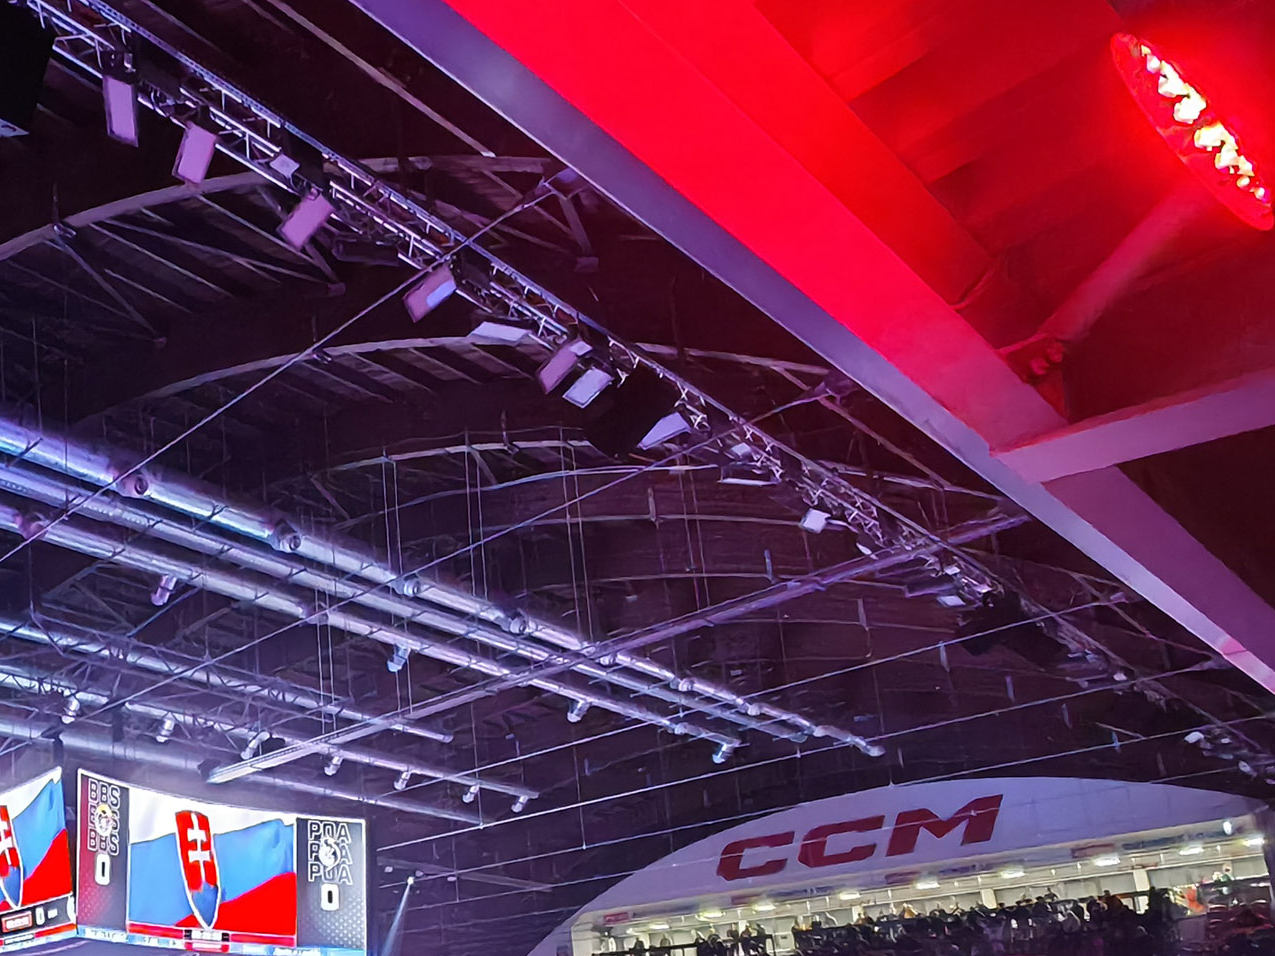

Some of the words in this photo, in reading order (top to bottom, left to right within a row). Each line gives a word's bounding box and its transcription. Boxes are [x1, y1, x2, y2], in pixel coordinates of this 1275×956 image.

[88, 778, 120, 809] BBS
[716, 794, 1004, 881] CCM
[321, 884, 339, 910] 0
